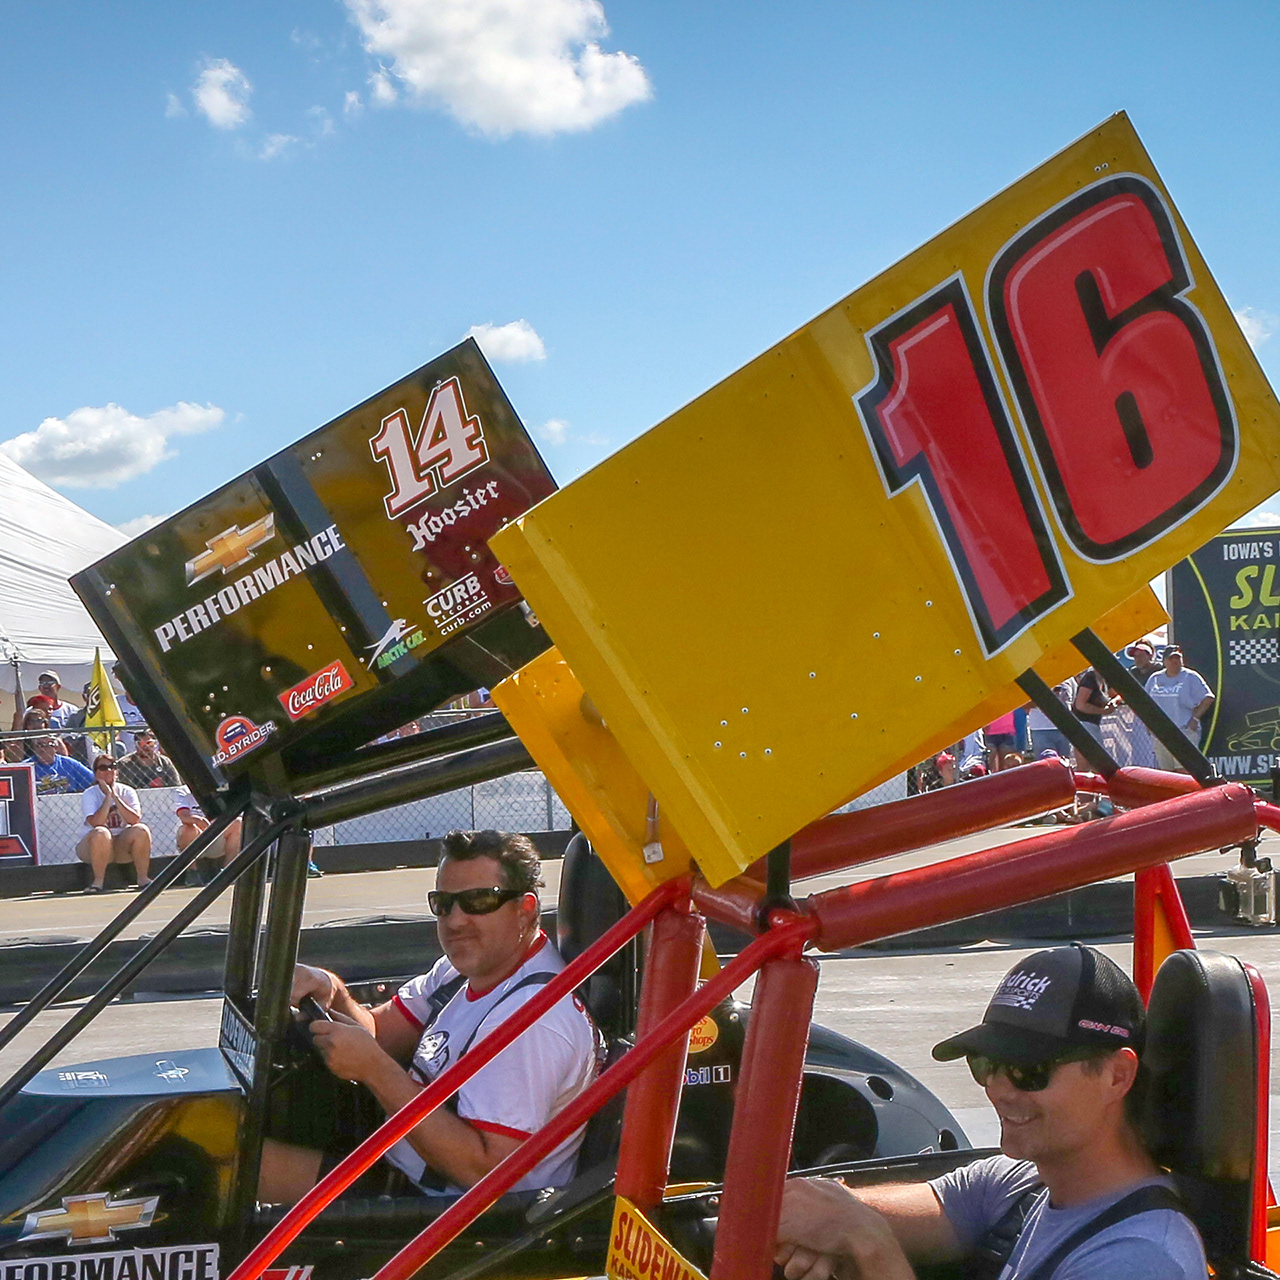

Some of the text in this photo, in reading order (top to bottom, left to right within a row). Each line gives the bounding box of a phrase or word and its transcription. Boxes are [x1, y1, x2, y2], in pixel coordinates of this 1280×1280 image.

[853, 173, 1240, 660] 16
[370, 376, 490, 520] 14
[406, 481, 499, 551] Hoosier
[1223, 542, 1273, 560] IOWA'S
[154, 524, 347, 653] PERFORMANCE
[426, 575, 481, 617] CURB
[434, 590, 486, 624] RECORDS
[440, 601, 492, 636] curb.com
[377, 637, 408, 669] ARCTIC
[228, 722, 276, 756] BYRIDER
